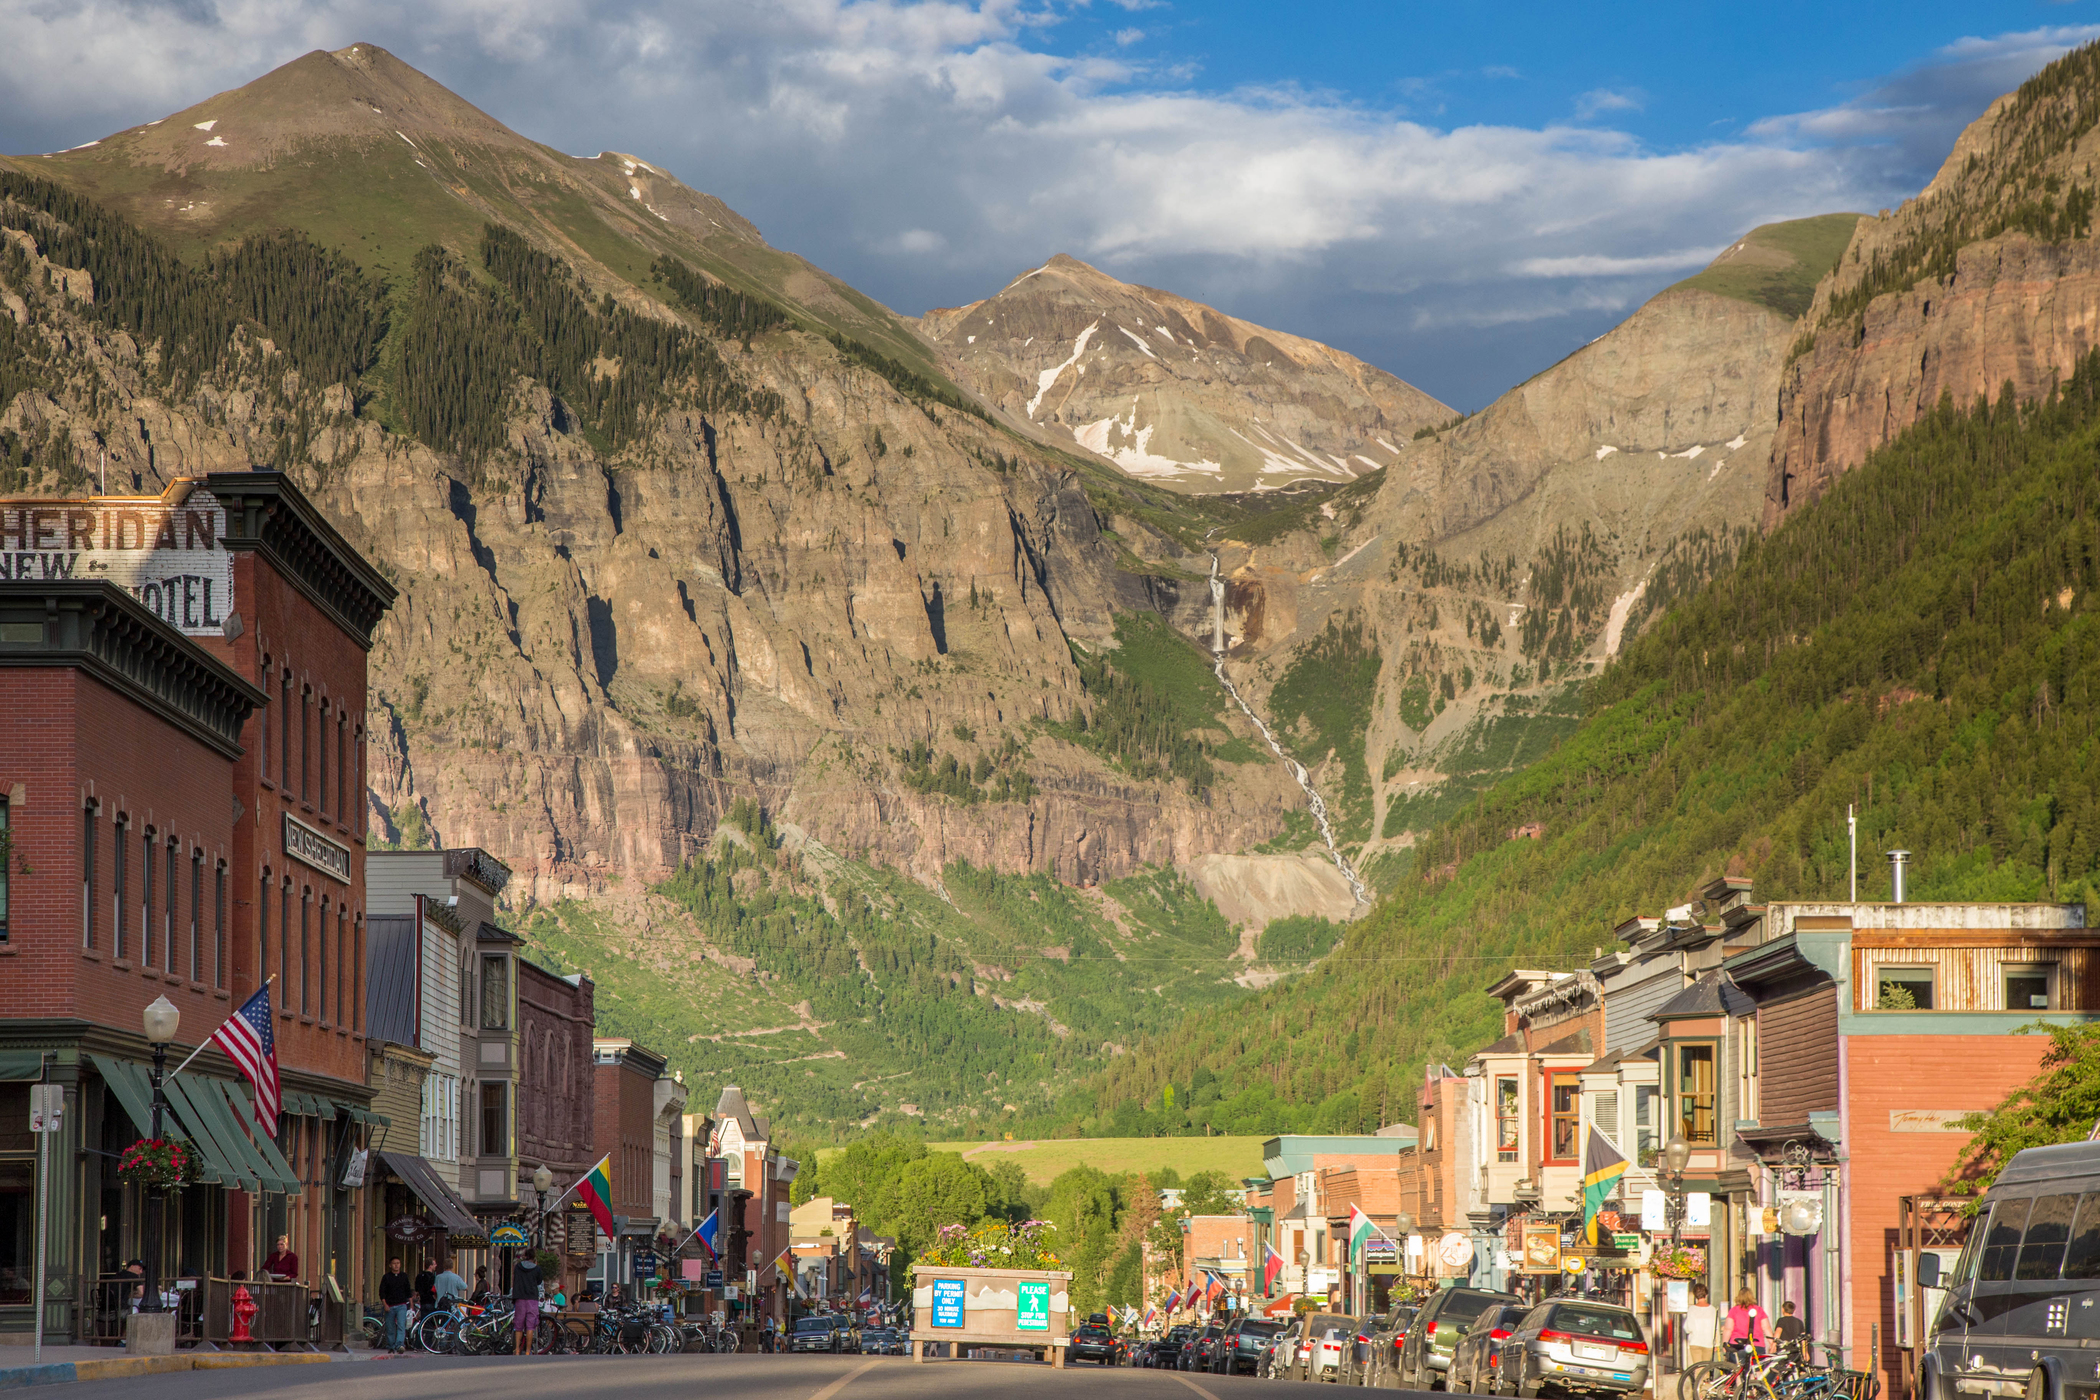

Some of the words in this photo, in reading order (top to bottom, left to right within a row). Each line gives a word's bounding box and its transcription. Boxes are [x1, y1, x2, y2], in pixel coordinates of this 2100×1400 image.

[127, 574, 221, 627] OTEL
[286, 823, 304, 855] NEW
[304, 833, 346, 876] SHERIDAN
[937, 1282, 961, 1290] PARKING
[1021, 1286, 1047, 1294] PLEASE
